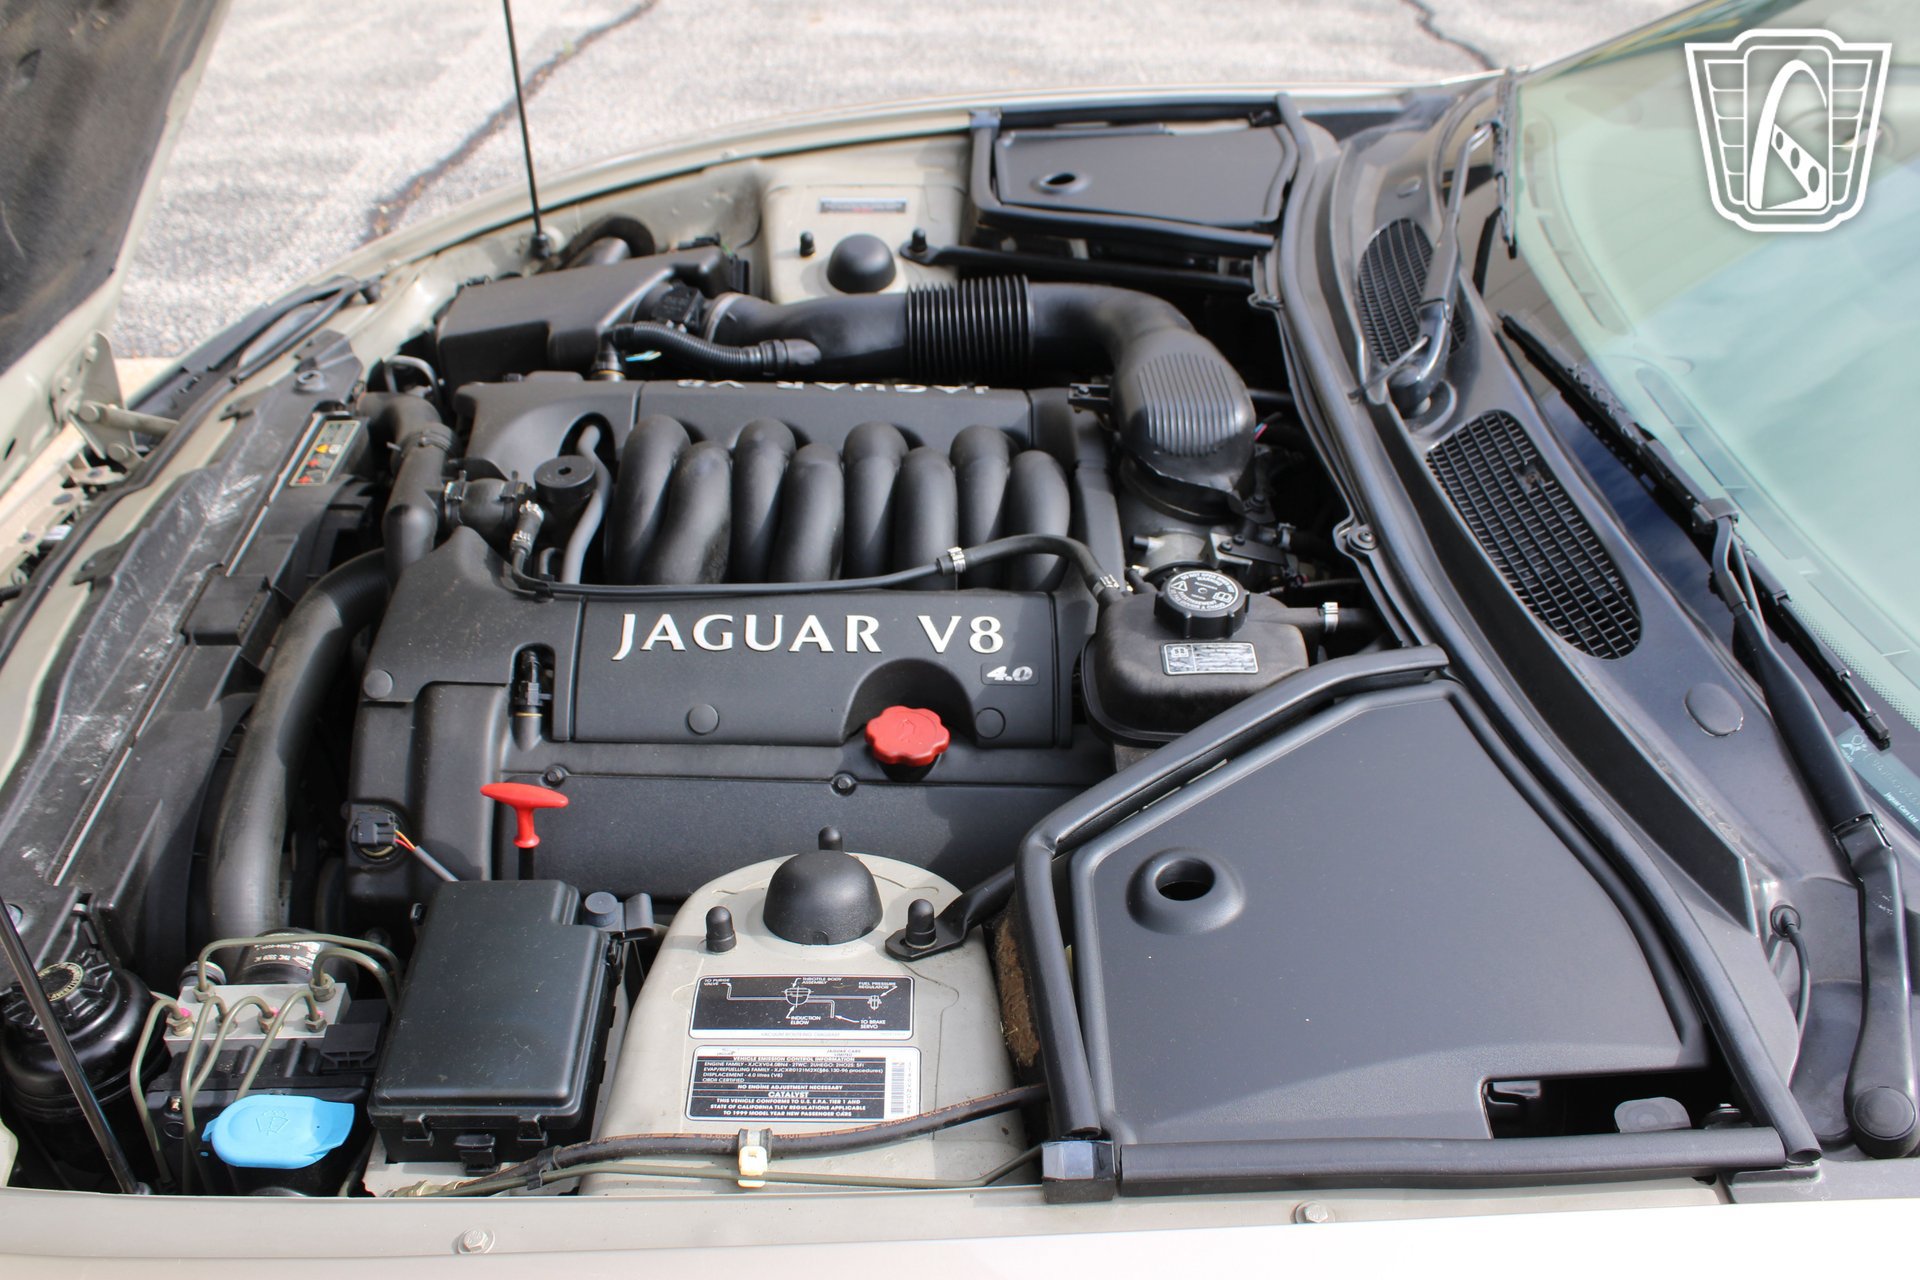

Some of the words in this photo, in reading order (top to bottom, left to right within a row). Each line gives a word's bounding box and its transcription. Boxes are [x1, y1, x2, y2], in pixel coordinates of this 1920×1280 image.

[611, 613, 882, 661] JAGUAR
[918, 615, 1004, 653] V8
[986, 665, 1033, 682] 4.0
